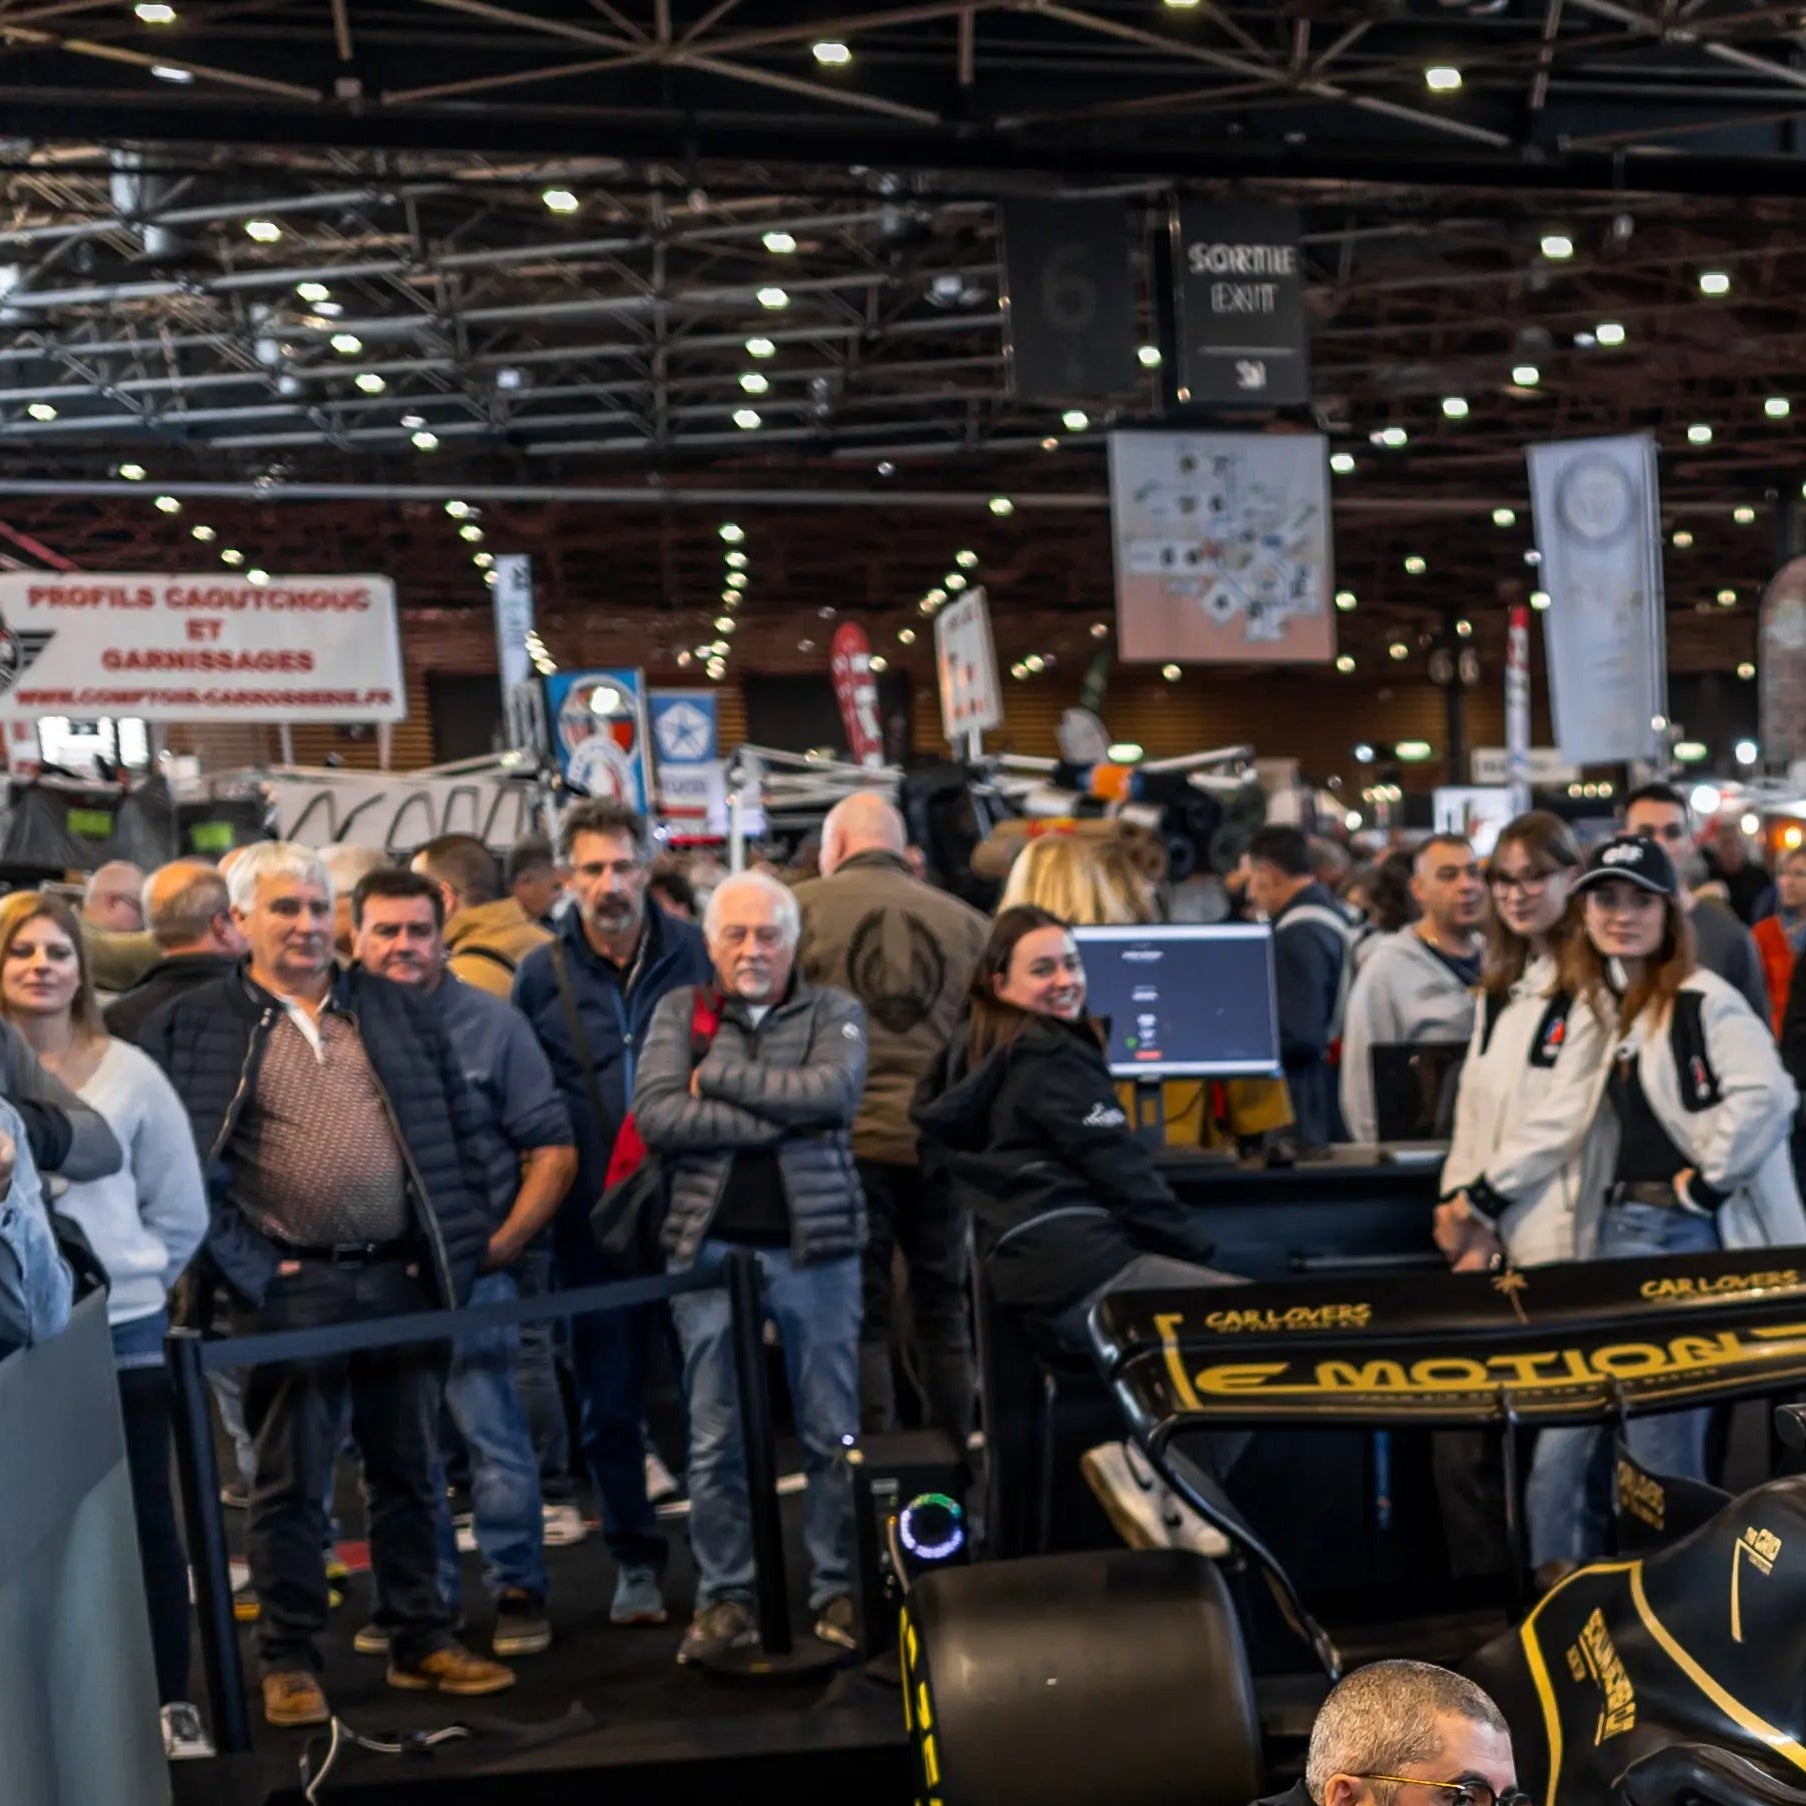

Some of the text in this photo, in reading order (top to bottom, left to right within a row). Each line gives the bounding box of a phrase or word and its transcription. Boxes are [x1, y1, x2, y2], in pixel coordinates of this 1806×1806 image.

[1187, 241, 1297, 275] SORTIE
[1211, 282, 1278, 313] EXIT
[26, 584, 372, 613] PROFILS CAOUTCHOUC
[185, 617, 225, 641] ET
[102, 648, 316, 673] GARNISSAGES
[1640, 1269, 1800, 1298] CAR LOVERS
[1205, 1310, 1261, 1329] CAR
[1266, 1302, 1372, 1324] LOVERS
